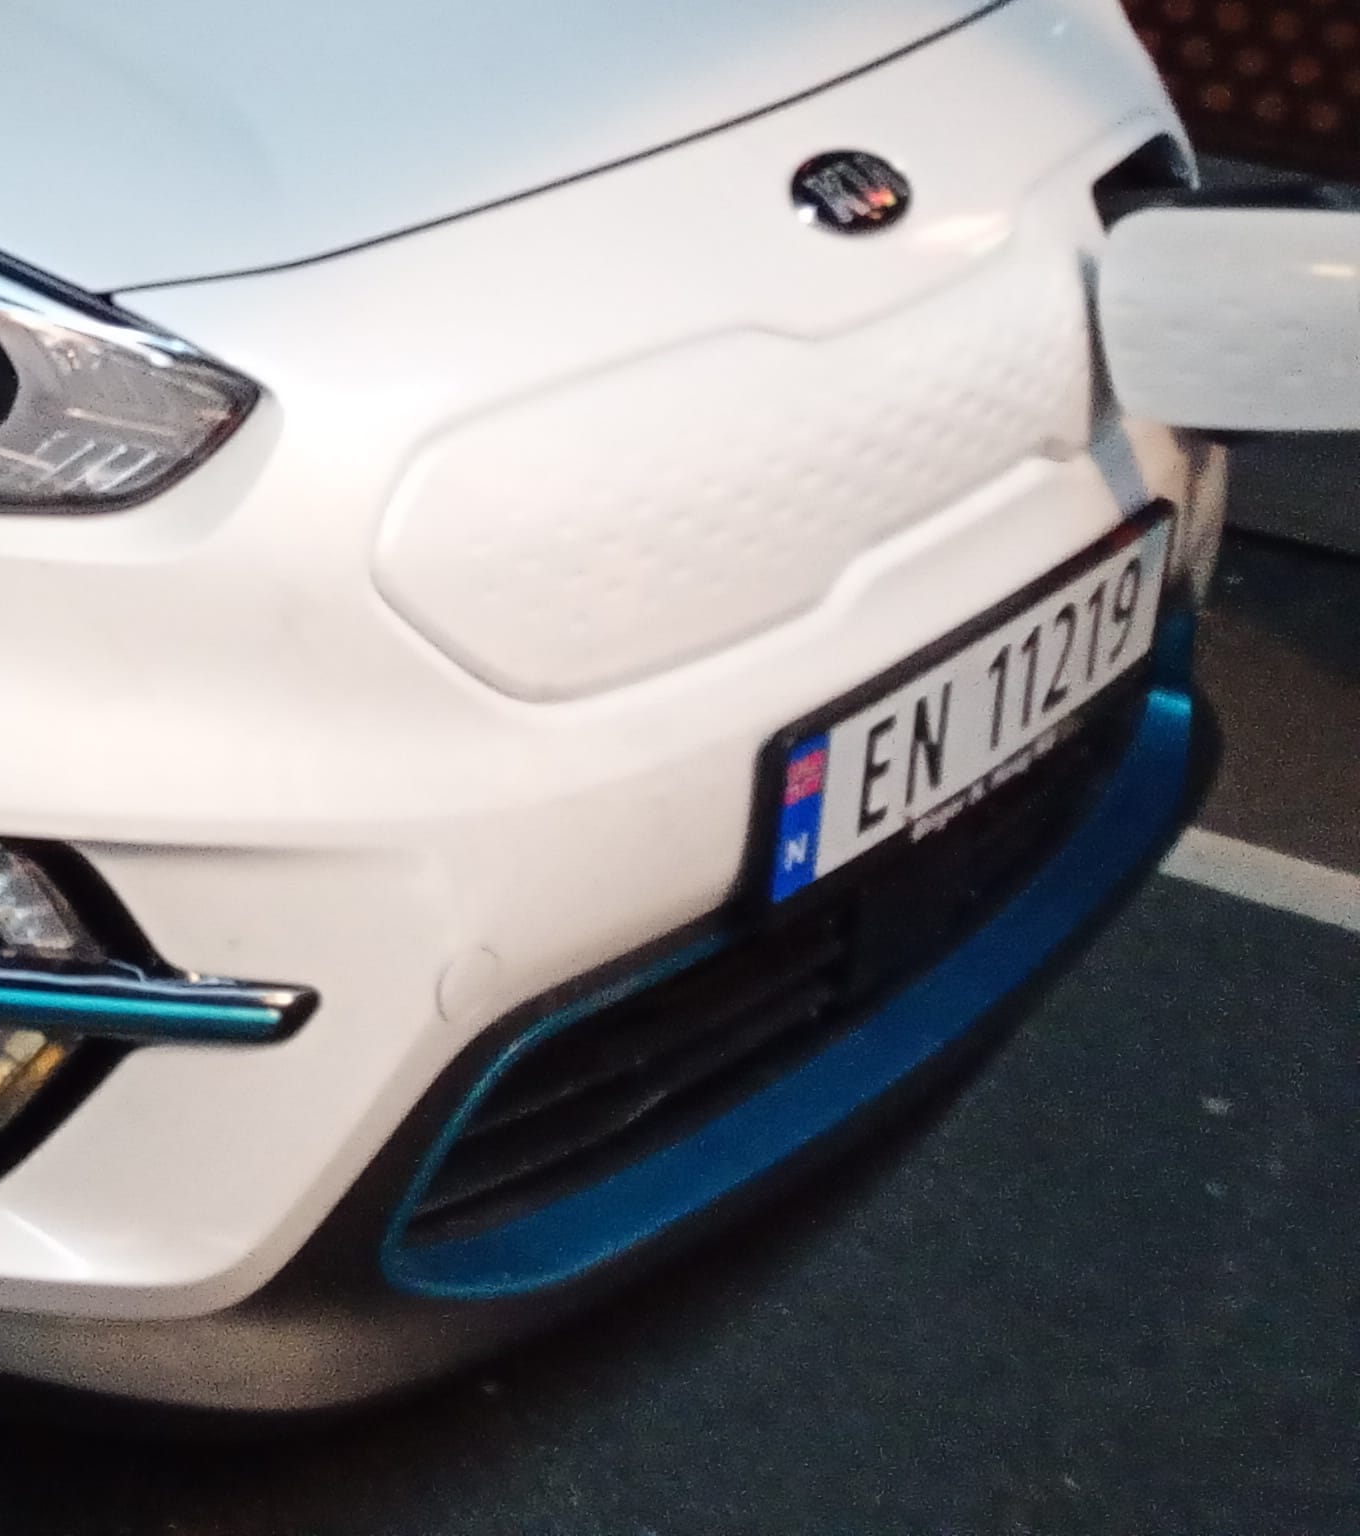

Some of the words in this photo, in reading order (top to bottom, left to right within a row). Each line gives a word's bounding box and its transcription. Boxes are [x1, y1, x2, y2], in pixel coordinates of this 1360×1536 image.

[857, 681, 953, 837] EN
[988, 557, 1143, 752] 11219
[783, 832, 809, 872] N
